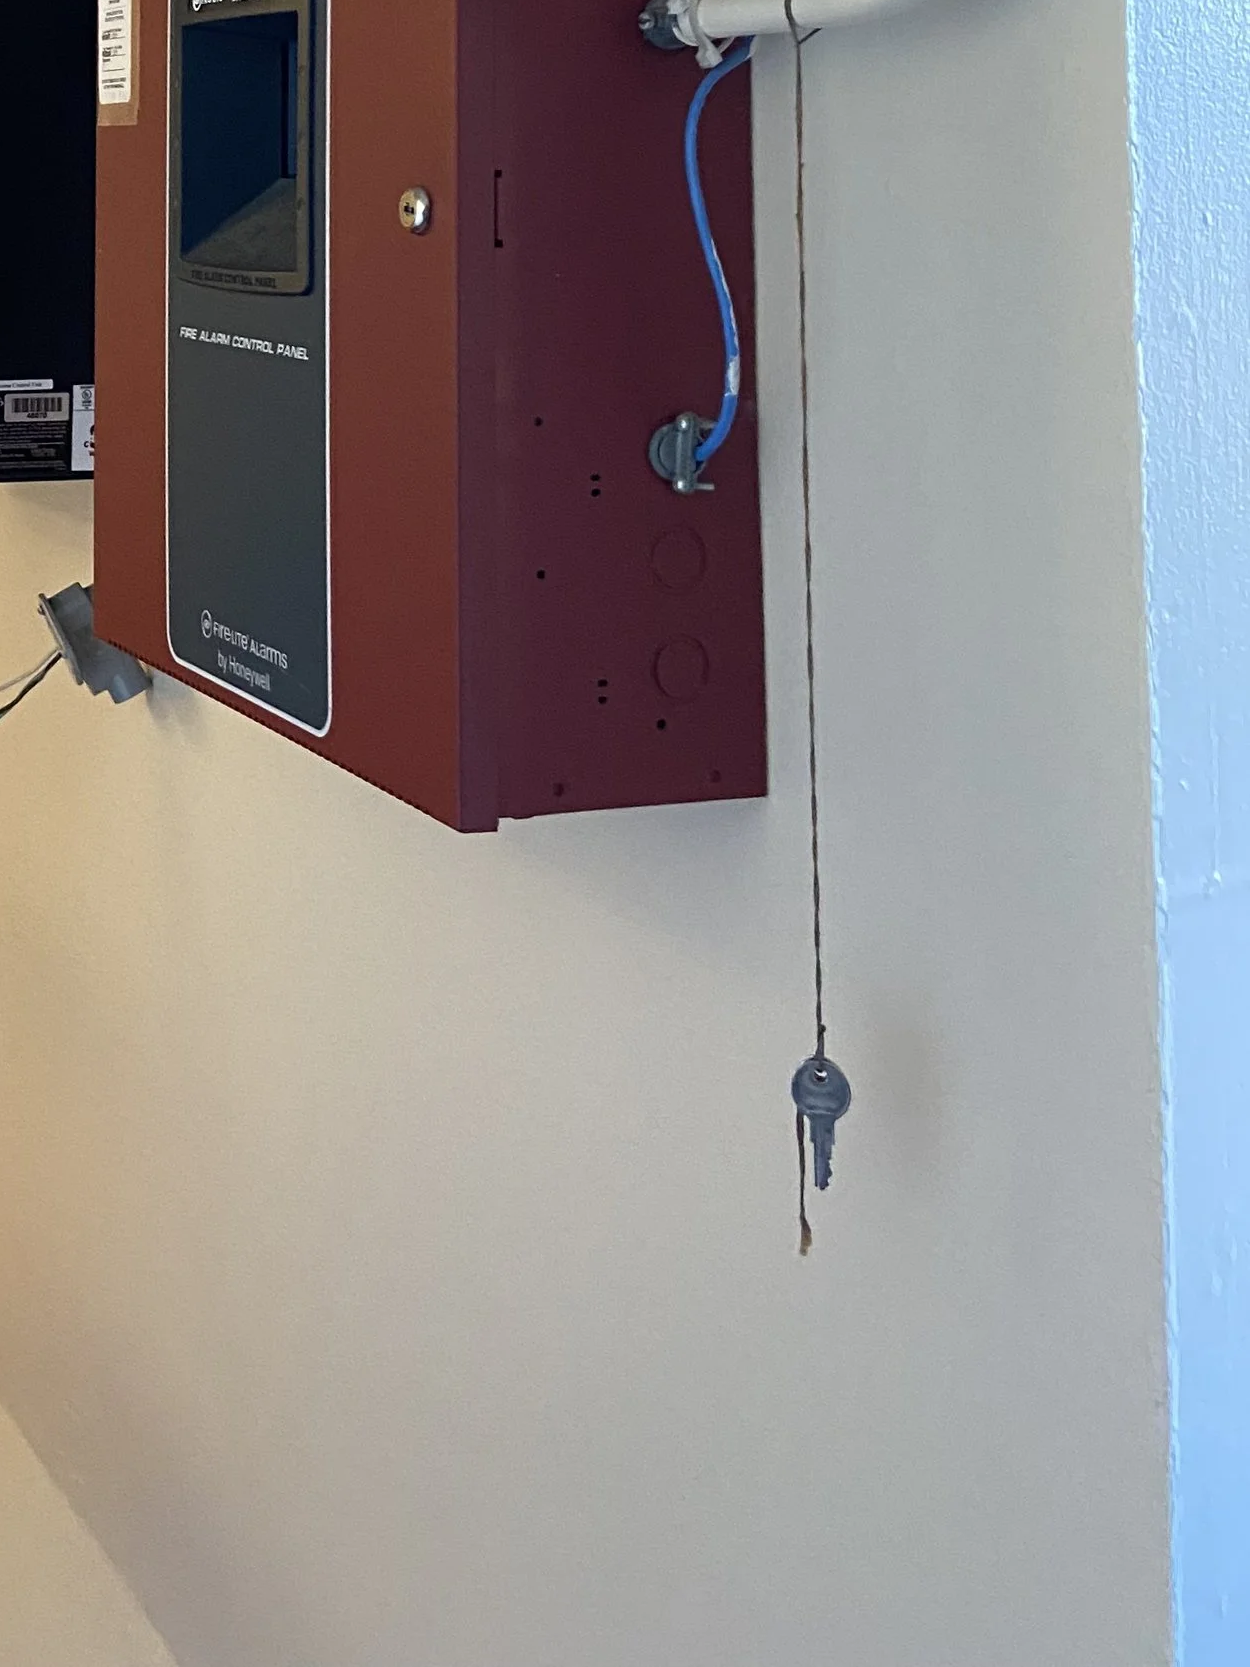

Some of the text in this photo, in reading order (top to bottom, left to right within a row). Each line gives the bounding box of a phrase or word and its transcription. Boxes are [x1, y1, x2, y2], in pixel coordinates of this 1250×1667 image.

[179, 326, 309, 360] FIRE ALARM CONTROL PANEL
[217, 648, 271, 691] by Honeywell
